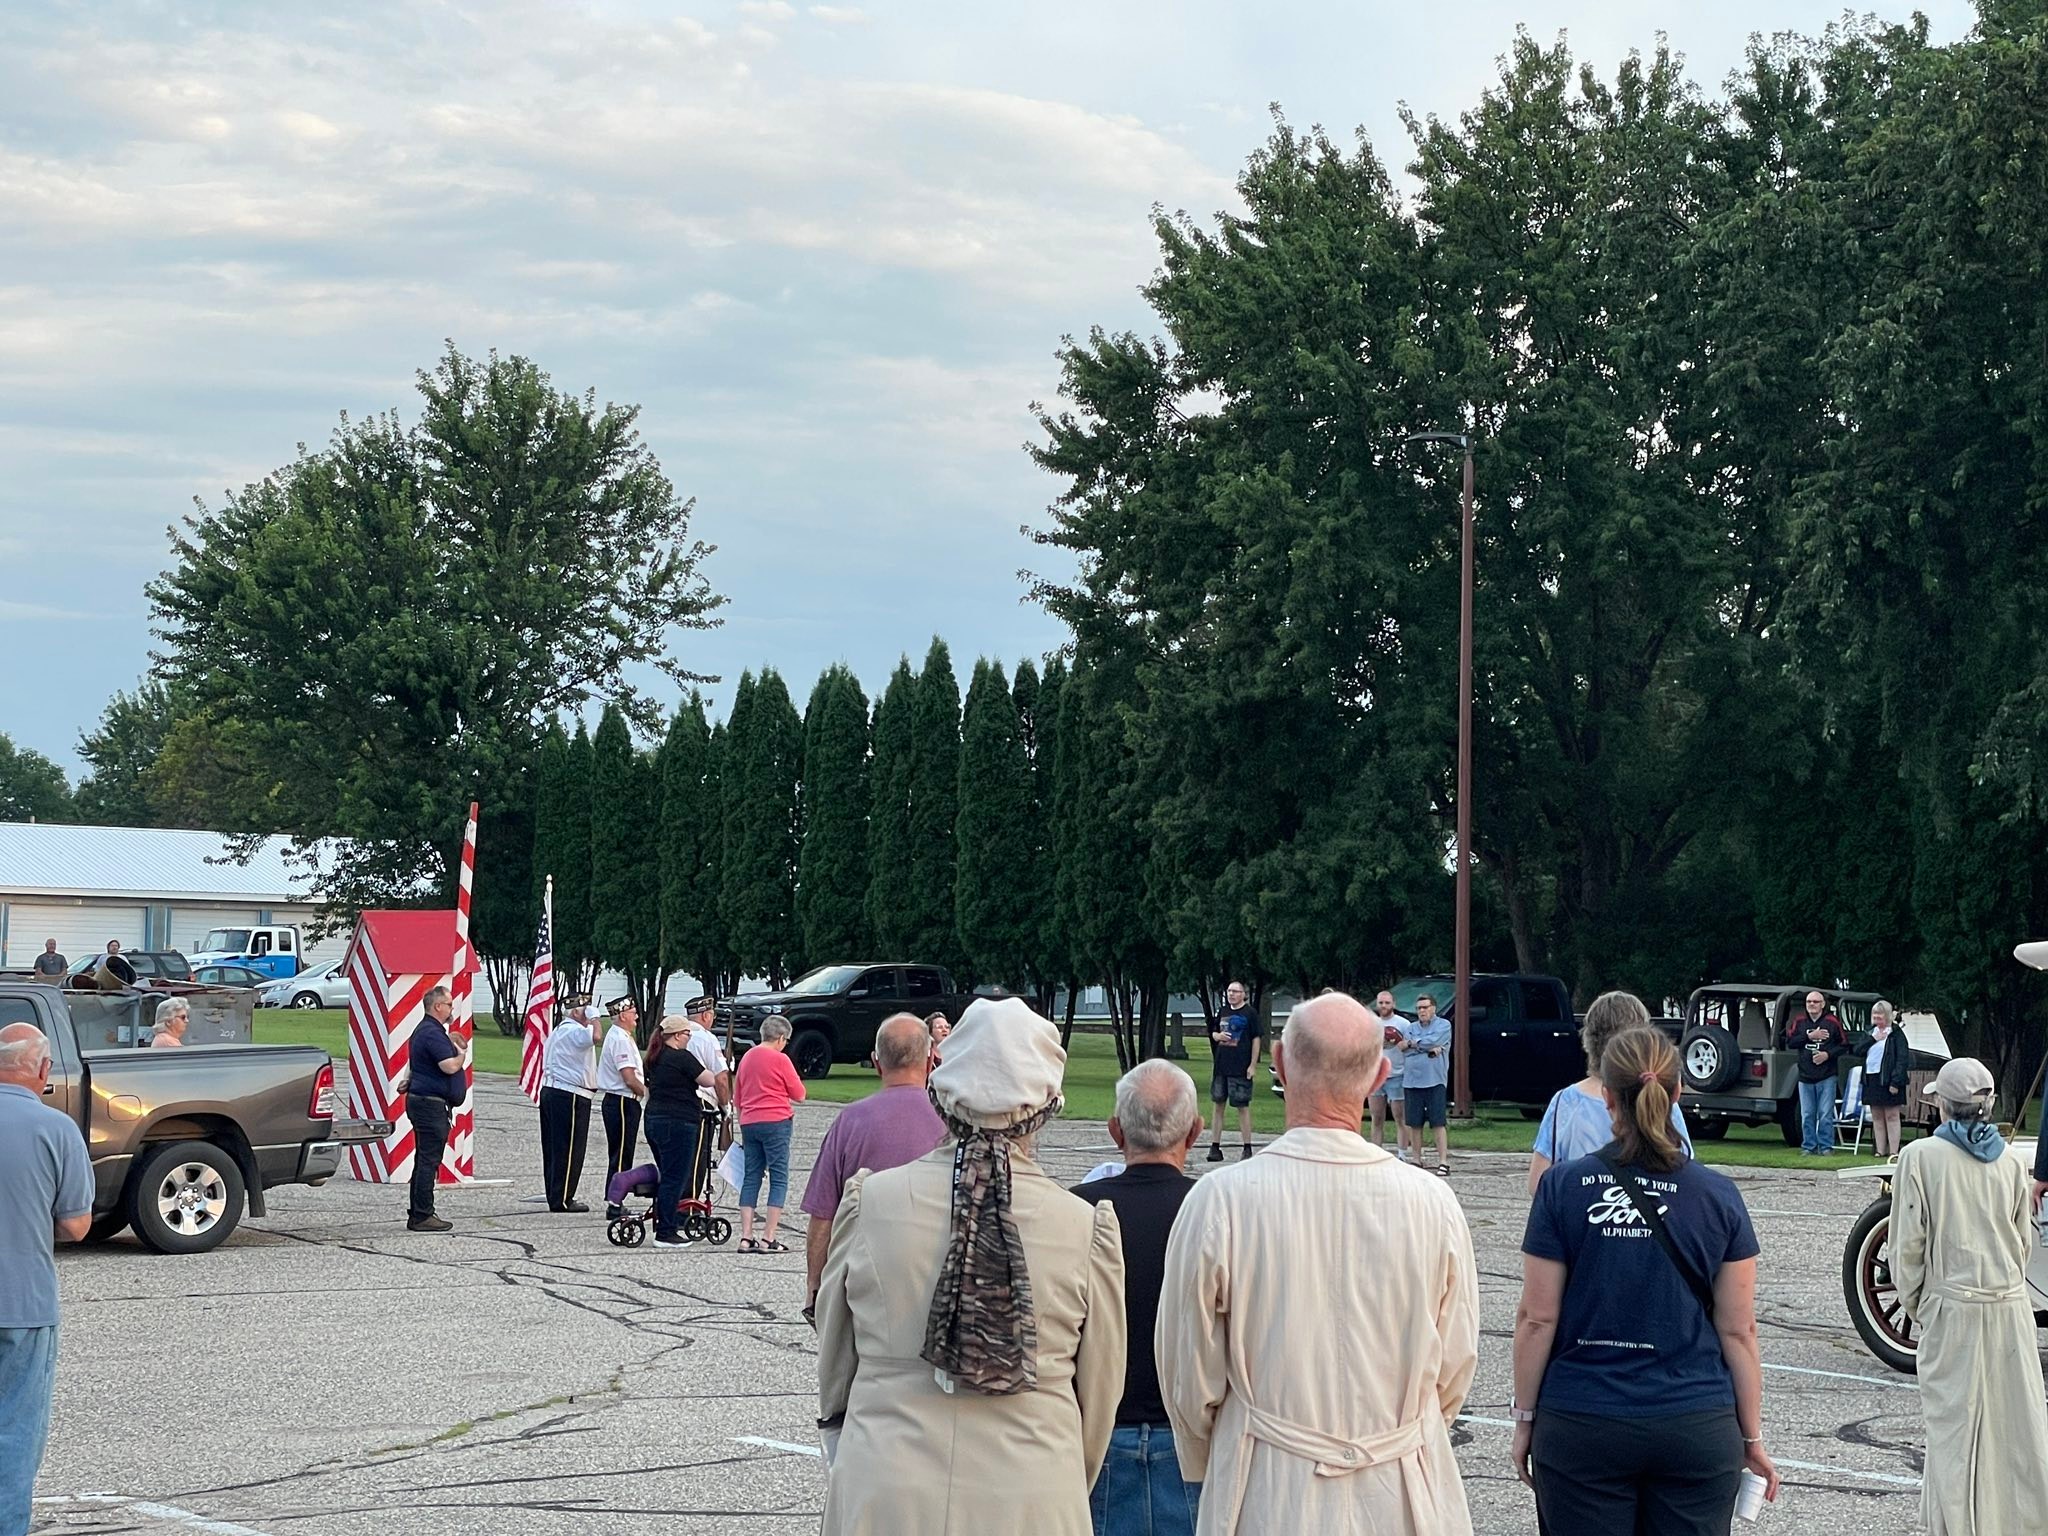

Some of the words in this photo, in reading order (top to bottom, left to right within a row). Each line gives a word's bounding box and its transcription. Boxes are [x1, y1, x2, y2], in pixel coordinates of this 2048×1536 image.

[1582, 1175, 1595, 1186] DO
[1598, 1174, 1616, 1184] YOU
[1652, 1180, 1678, 1193] YOUR
[1601, 1227, 1653, 1238] ALPHABET?
